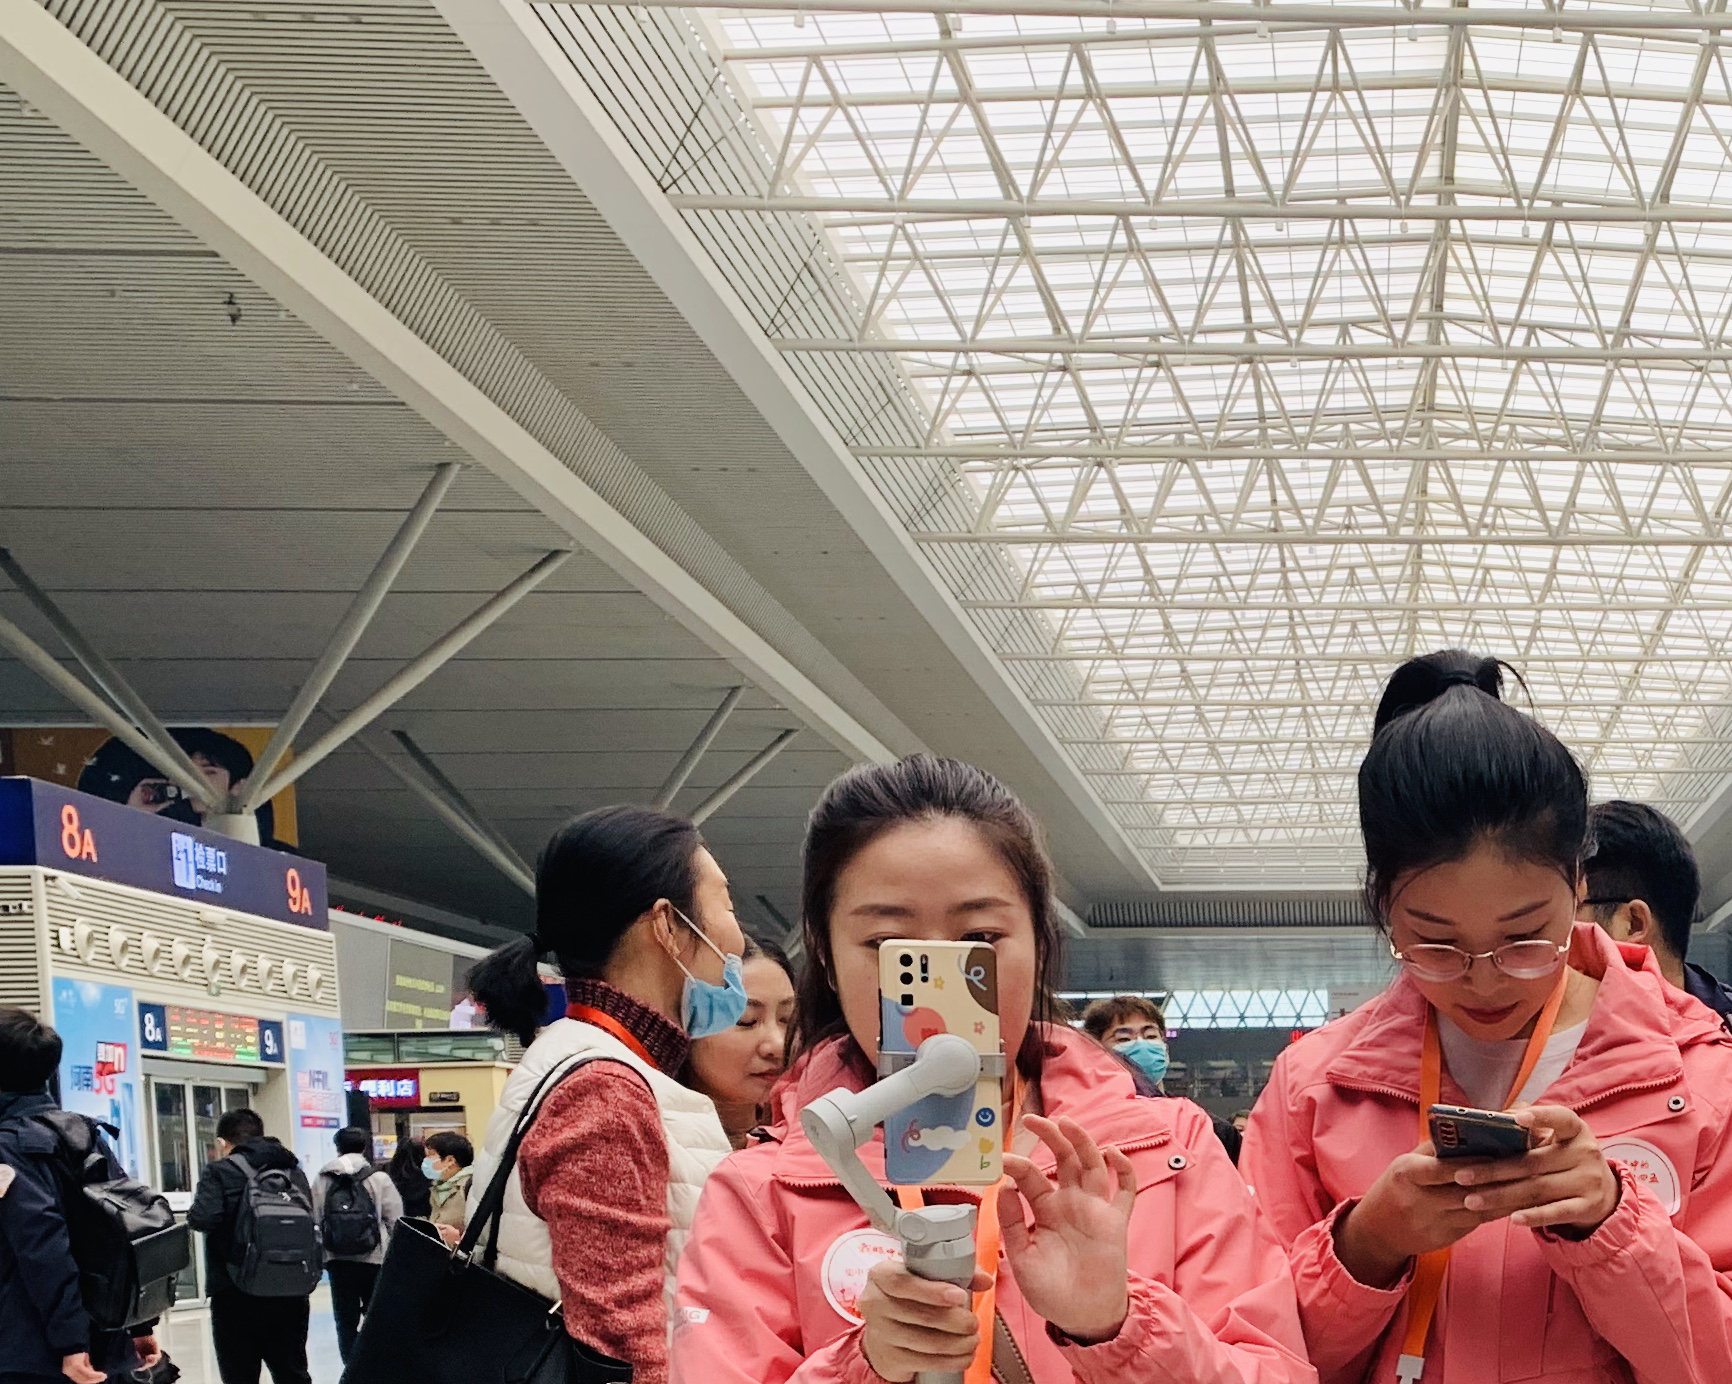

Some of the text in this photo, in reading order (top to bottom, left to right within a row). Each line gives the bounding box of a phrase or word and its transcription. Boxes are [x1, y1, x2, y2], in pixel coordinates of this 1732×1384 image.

[60, 803, 98, 864] 8A
[194, 842, 228, 876] 检票口
[286, 867, 313, 917] 9A
[144, 1012, 163, 1042] 8A
